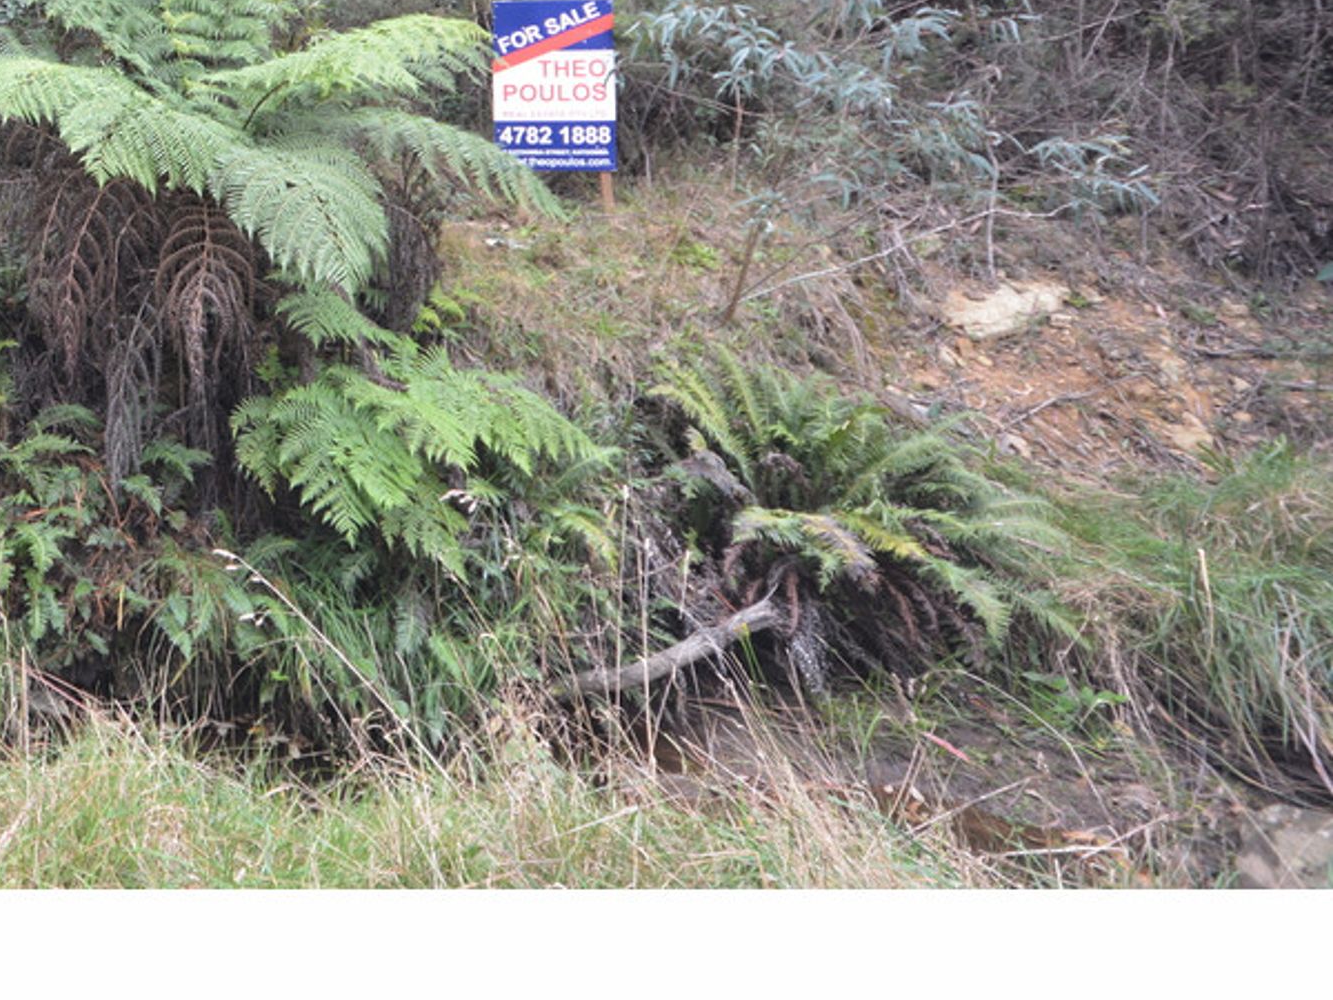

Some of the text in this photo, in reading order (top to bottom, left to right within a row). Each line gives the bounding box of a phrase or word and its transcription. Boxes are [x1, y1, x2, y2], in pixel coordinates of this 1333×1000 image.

[497, 1, 601, 54] FOR SALE
[538, 59, 607, 77] THEO
[503, 83, 607, 102] POULOS
[499, 125, 612, 145] 4782 1888
